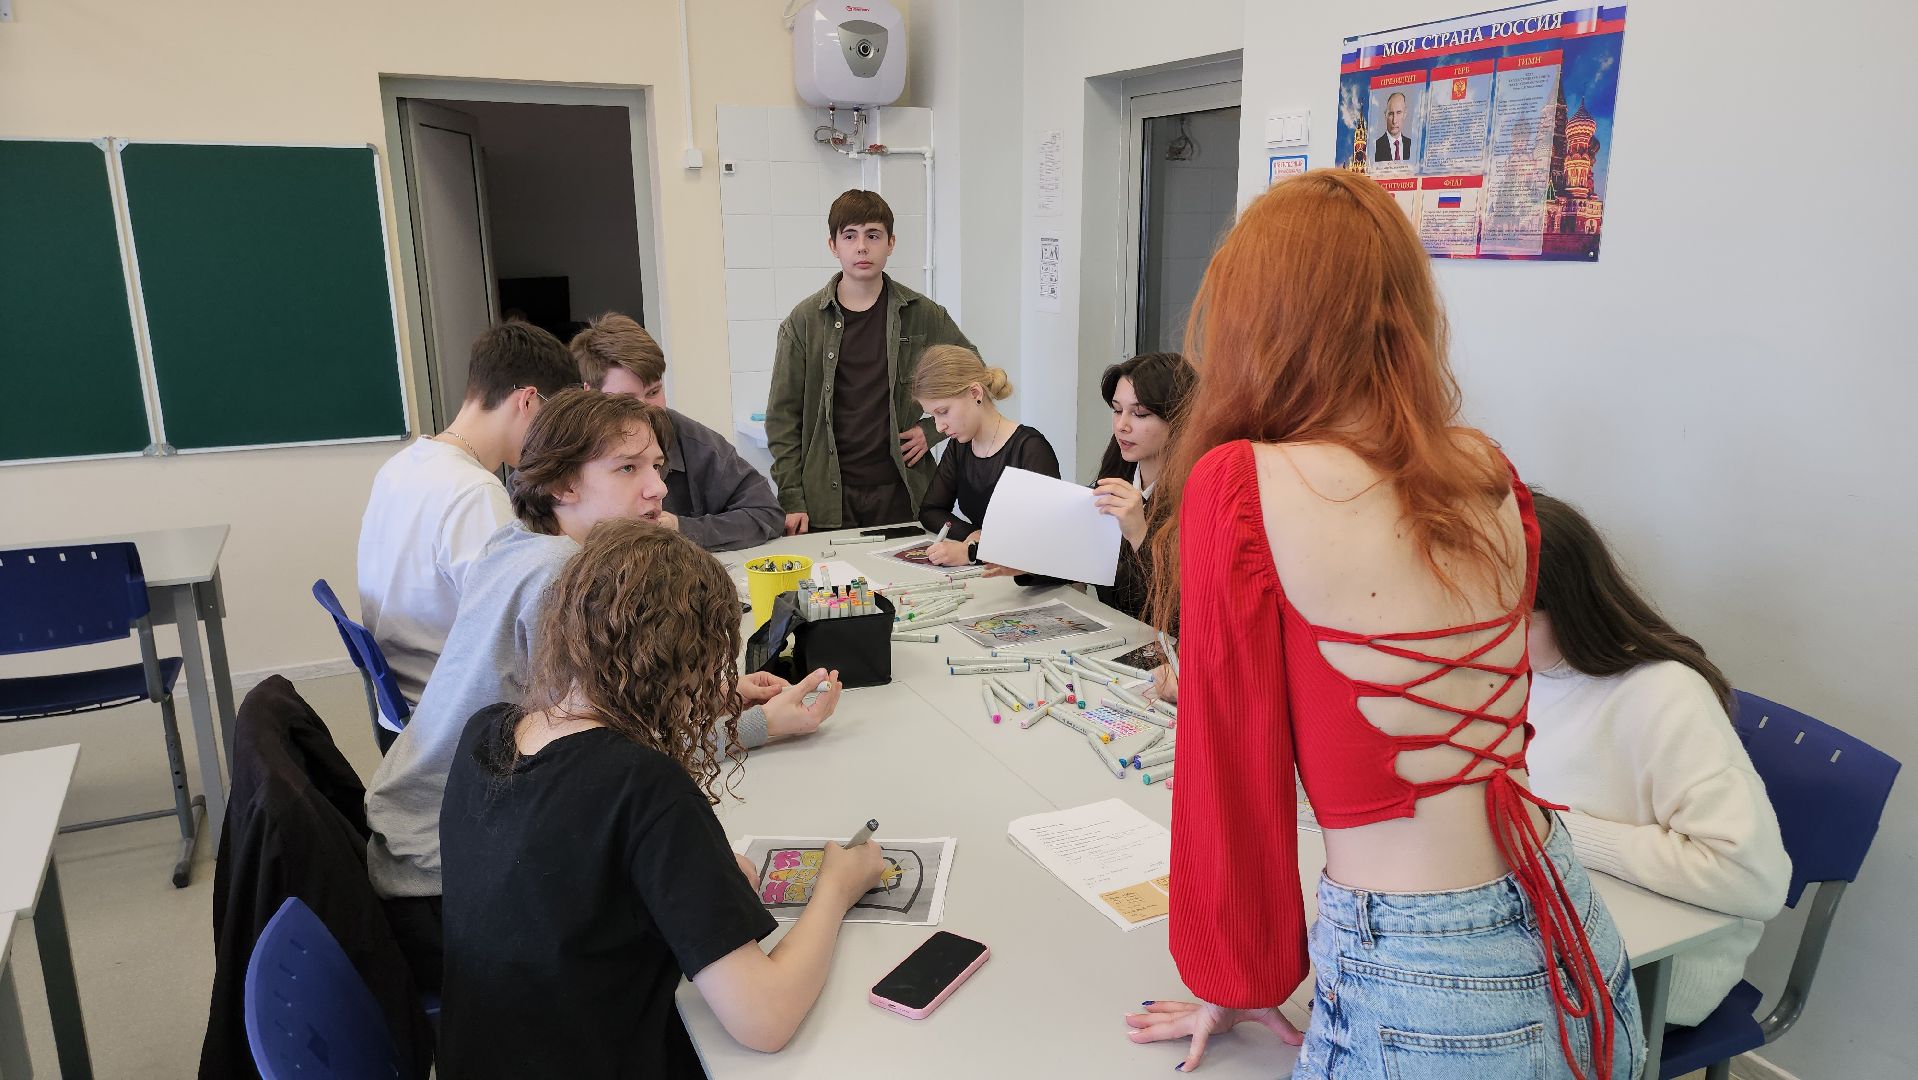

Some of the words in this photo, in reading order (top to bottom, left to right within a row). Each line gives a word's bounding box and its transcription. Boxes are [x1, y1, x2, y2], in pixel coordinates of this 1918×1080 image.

[1382, 37, 1416, 58] МОЯ
[1421, 26, 1484, 51] СТРАНА
[1490, 12, 1564, 40] РОССИЯ
[1517, 56, 1542, 67] ГИМН
[1453, 66, 1470, 76] ГЕРБ
[1380, 74, 1417, 87] ПРЕЗИДЕНТ
[1380, 181, 1415, 190] СТИТУЦИЯ
[1443, 178, 1463, 187] ФЛАГ
